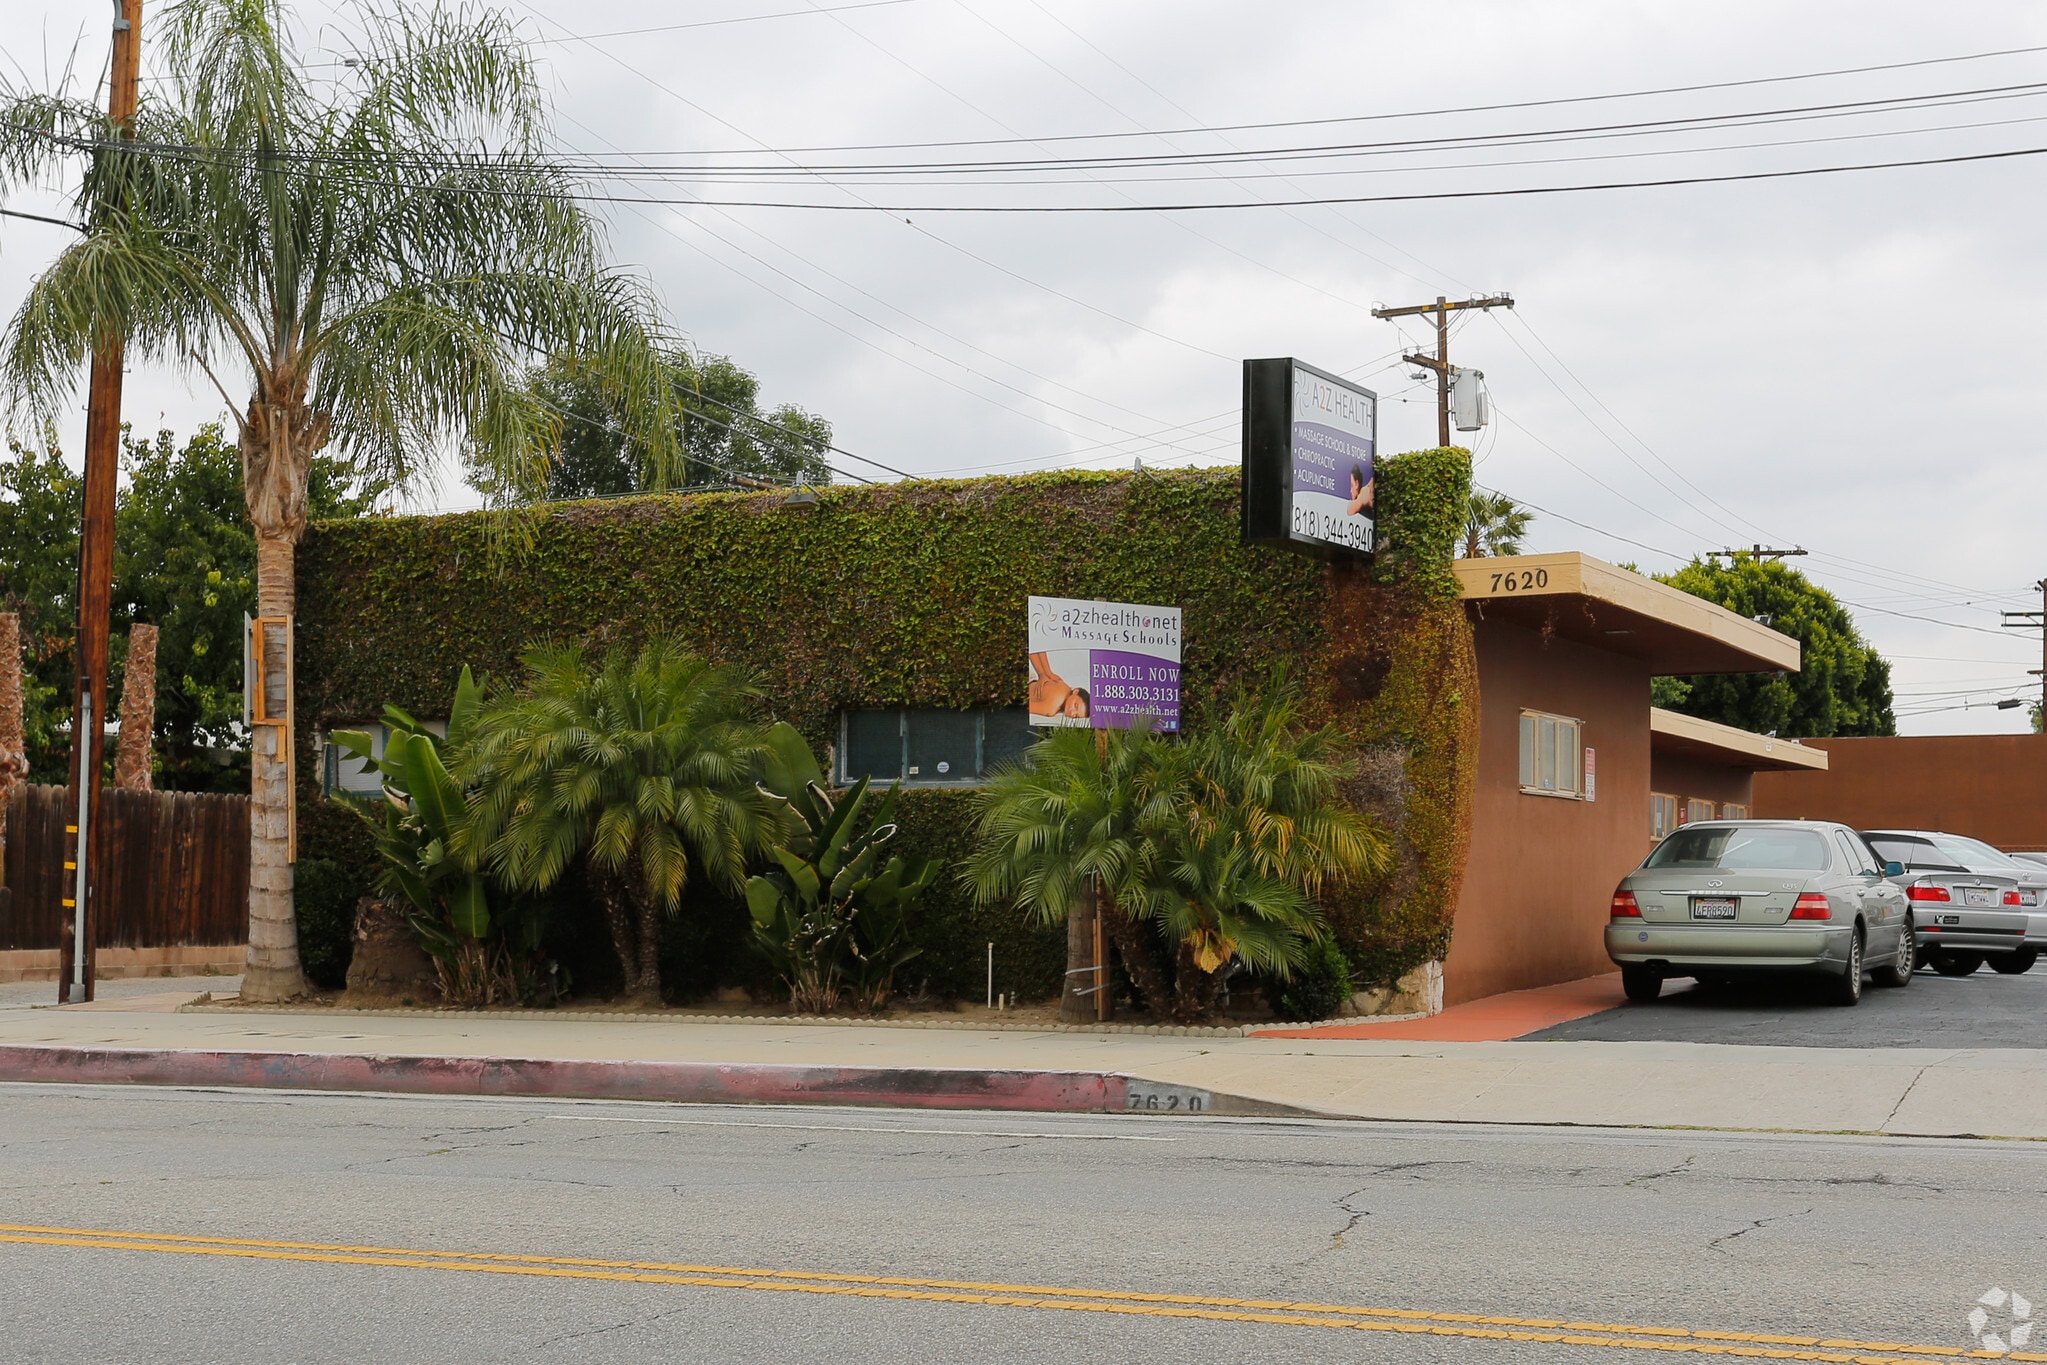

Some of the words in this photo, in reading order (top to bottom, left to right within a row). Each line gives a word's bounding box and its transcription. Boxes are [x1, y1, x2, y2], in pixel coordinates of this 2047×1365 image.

[1312, 382, 1332, 413] A2Z
[1335, 389, 1373, 429] HEALTH
[1298, 427, 1324, 446] MASSAGE
[1325, 435, 1345, 454] SCHOOL
[1351, 445, 1366, 461] STORE
[1297, 446, 1335, 471] CHIROPRACTIC
[1297, 468, 1335, 491] ACUPUNCTURE
[1292, 505, 1320, 539] 818)
[1324, 515, 1373, 552] 344-3940
[1490, 568, 1548, 592] 7620
[1093, 664, 1143, 681] ENROLL
[1149, 667, 1180, 682] NOW
[1094, 684, 1180, 702] 1.888.303.3131
[1094, 703, 1178, 717] www.a2zhealth.net
[1129, 1093, 1202, 1111] 7620
